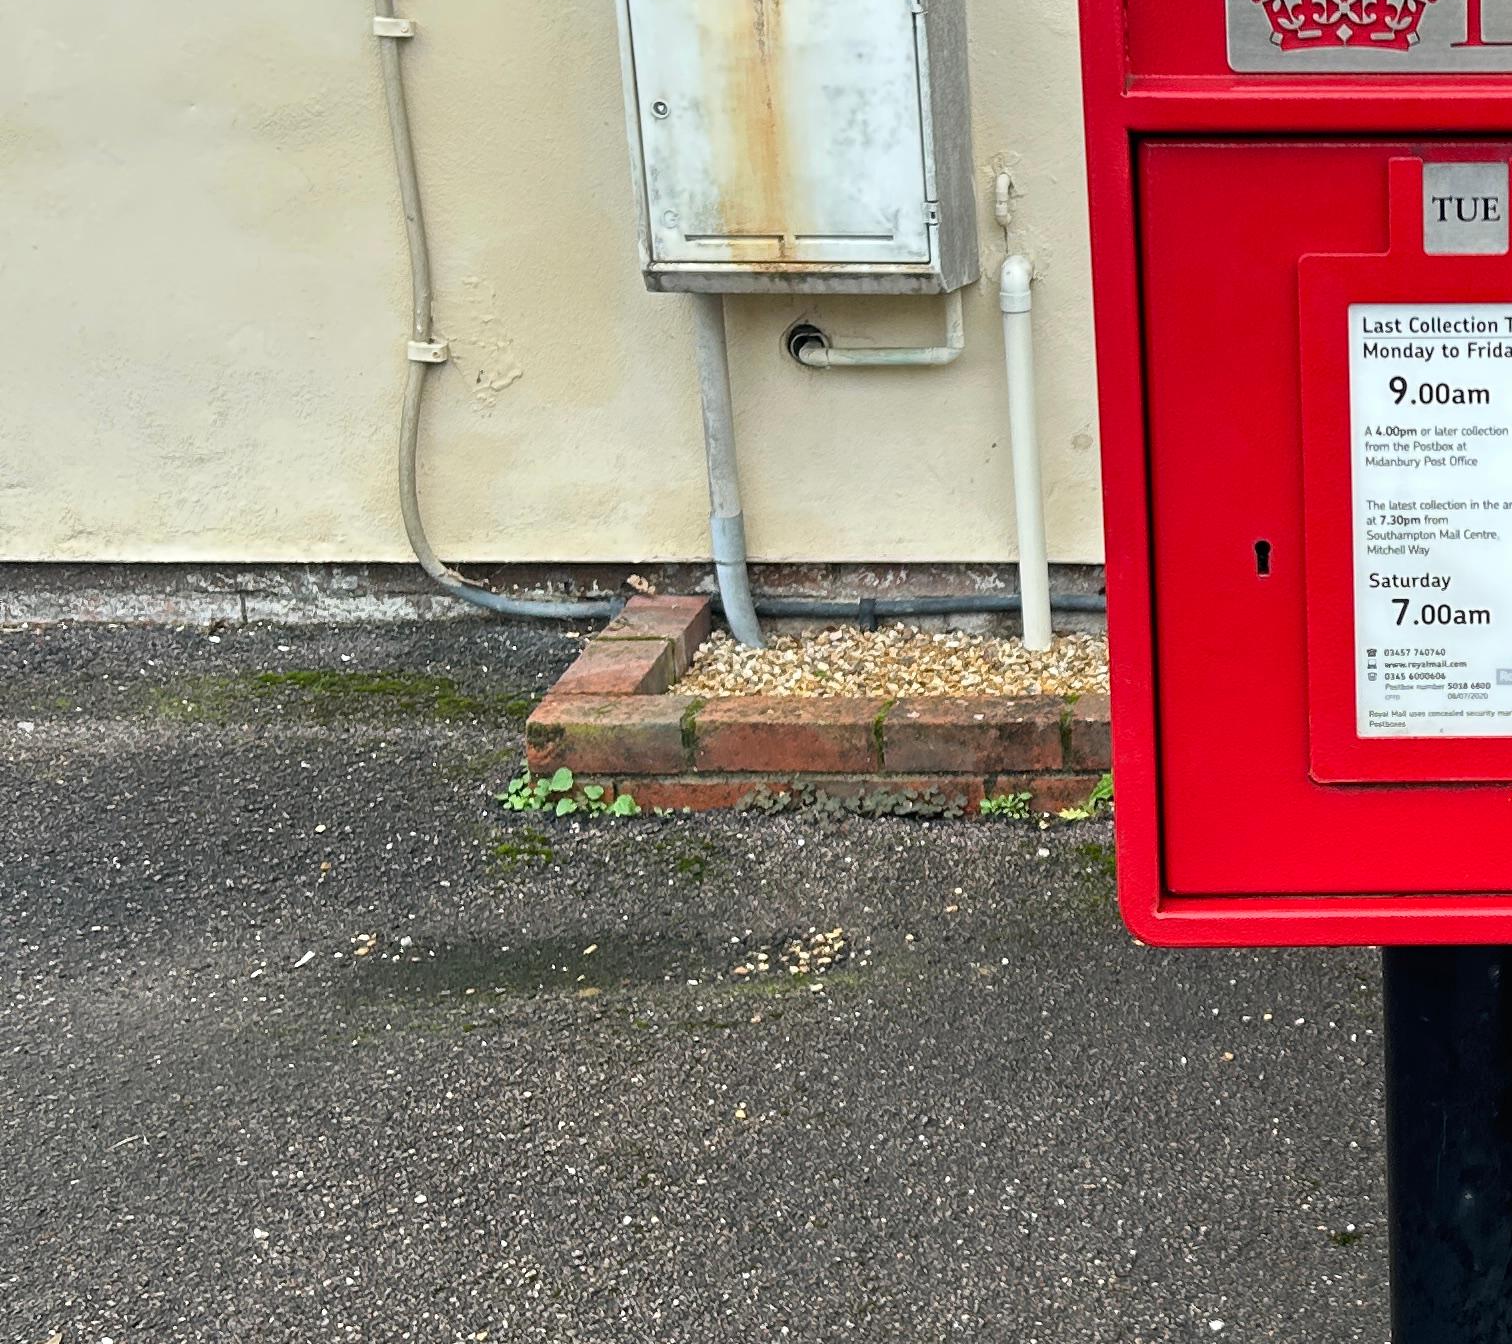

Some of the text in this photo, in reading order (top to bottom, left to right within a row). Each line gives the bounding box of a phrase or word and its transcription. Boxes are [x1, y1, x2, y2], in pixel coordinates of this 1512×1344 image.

[1432, 196, 1501, 223] TUE
[1363, 316, 1402, 333] Last
[1409, 316, 1498, 333] Collection
[1363, 341, 1434, 362] Monday
[1442, 343, 1459, 358] to
[1389, 376, 1490, 405] 9.00am
[1364, 426, 1372, 436] A
[1376, 426, 1417, 438] 4.00pm
[1421, 428, 1431, 436] or
[1435, 425, 1458, 436] later
[1461, 425, 1509, 436] collection
[1365, 441, 1467, 452] from the Postbox at
[1365, 456, 1478, 468] Midanbury Post Office
[1366, 499, 1385, 510] The
[1389, 499, 1417, 510] latest
[1420, 499, 1467, 510] collection
[1470, 499, 1479, 509] in
[1483, 499, 1499, 509] the
[1366, 514, 1449, 527] at 7.30pm from
[1366, 529, 1436, 541] Southampton
[1439, 529, 1460, 540] Mail
[1367, 544, 1430, 557] Mitchell Way
[1369, 572, 1451, 591] Saturday
[1391, 598, 1491, 626] 7.00am
[1384, 648, 1410, 657] 03457
[1385, 660, 1467, 669] www.royalmail.com
[1384, 672, 1406, 681] 0345
